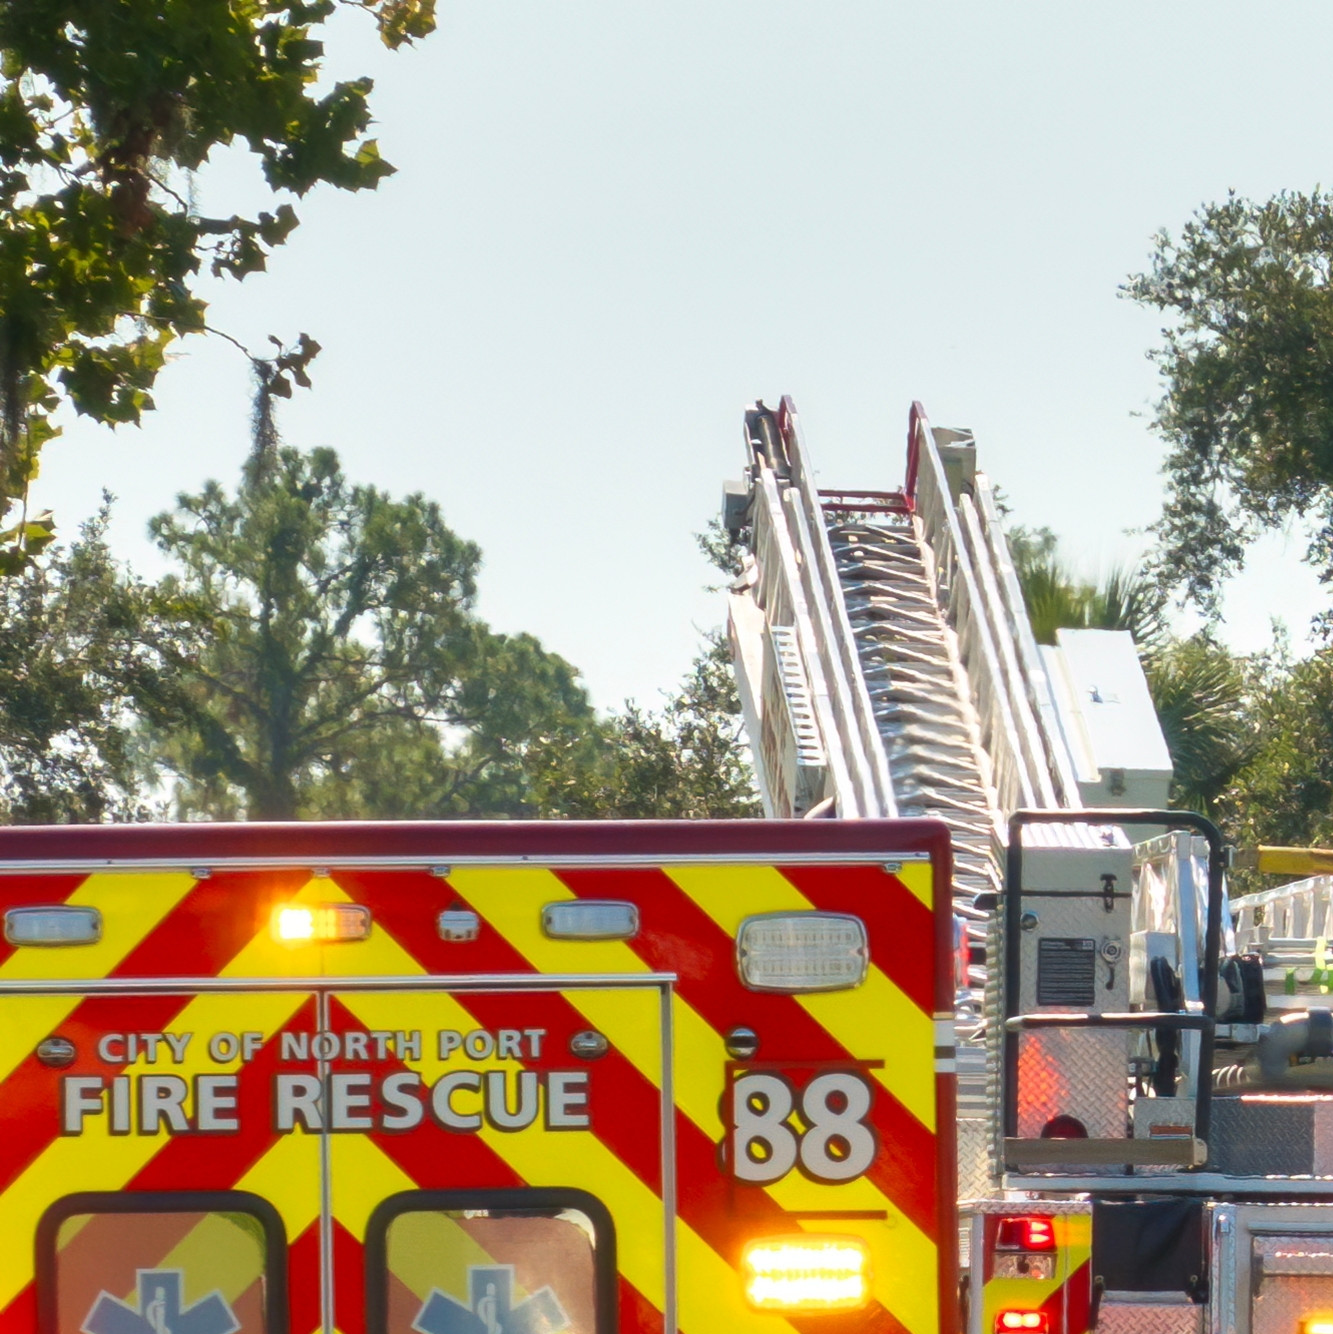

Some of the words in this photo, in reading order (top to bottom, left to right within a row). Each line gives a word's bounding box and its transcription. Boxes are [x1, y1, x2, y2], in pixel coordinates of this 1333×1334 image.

[98, 1032, 192, 1064] CITY
[209, 1032, 263, 1063] OF
[280, 1031, 421, 1061] NORTH
[438, 1028, 546, 1059] PORT
[62, 1073, 239, 1136] FIRE
[274, 1070, 590, 1134] RESCUE
[716, 1070, 878, 1187] 88
